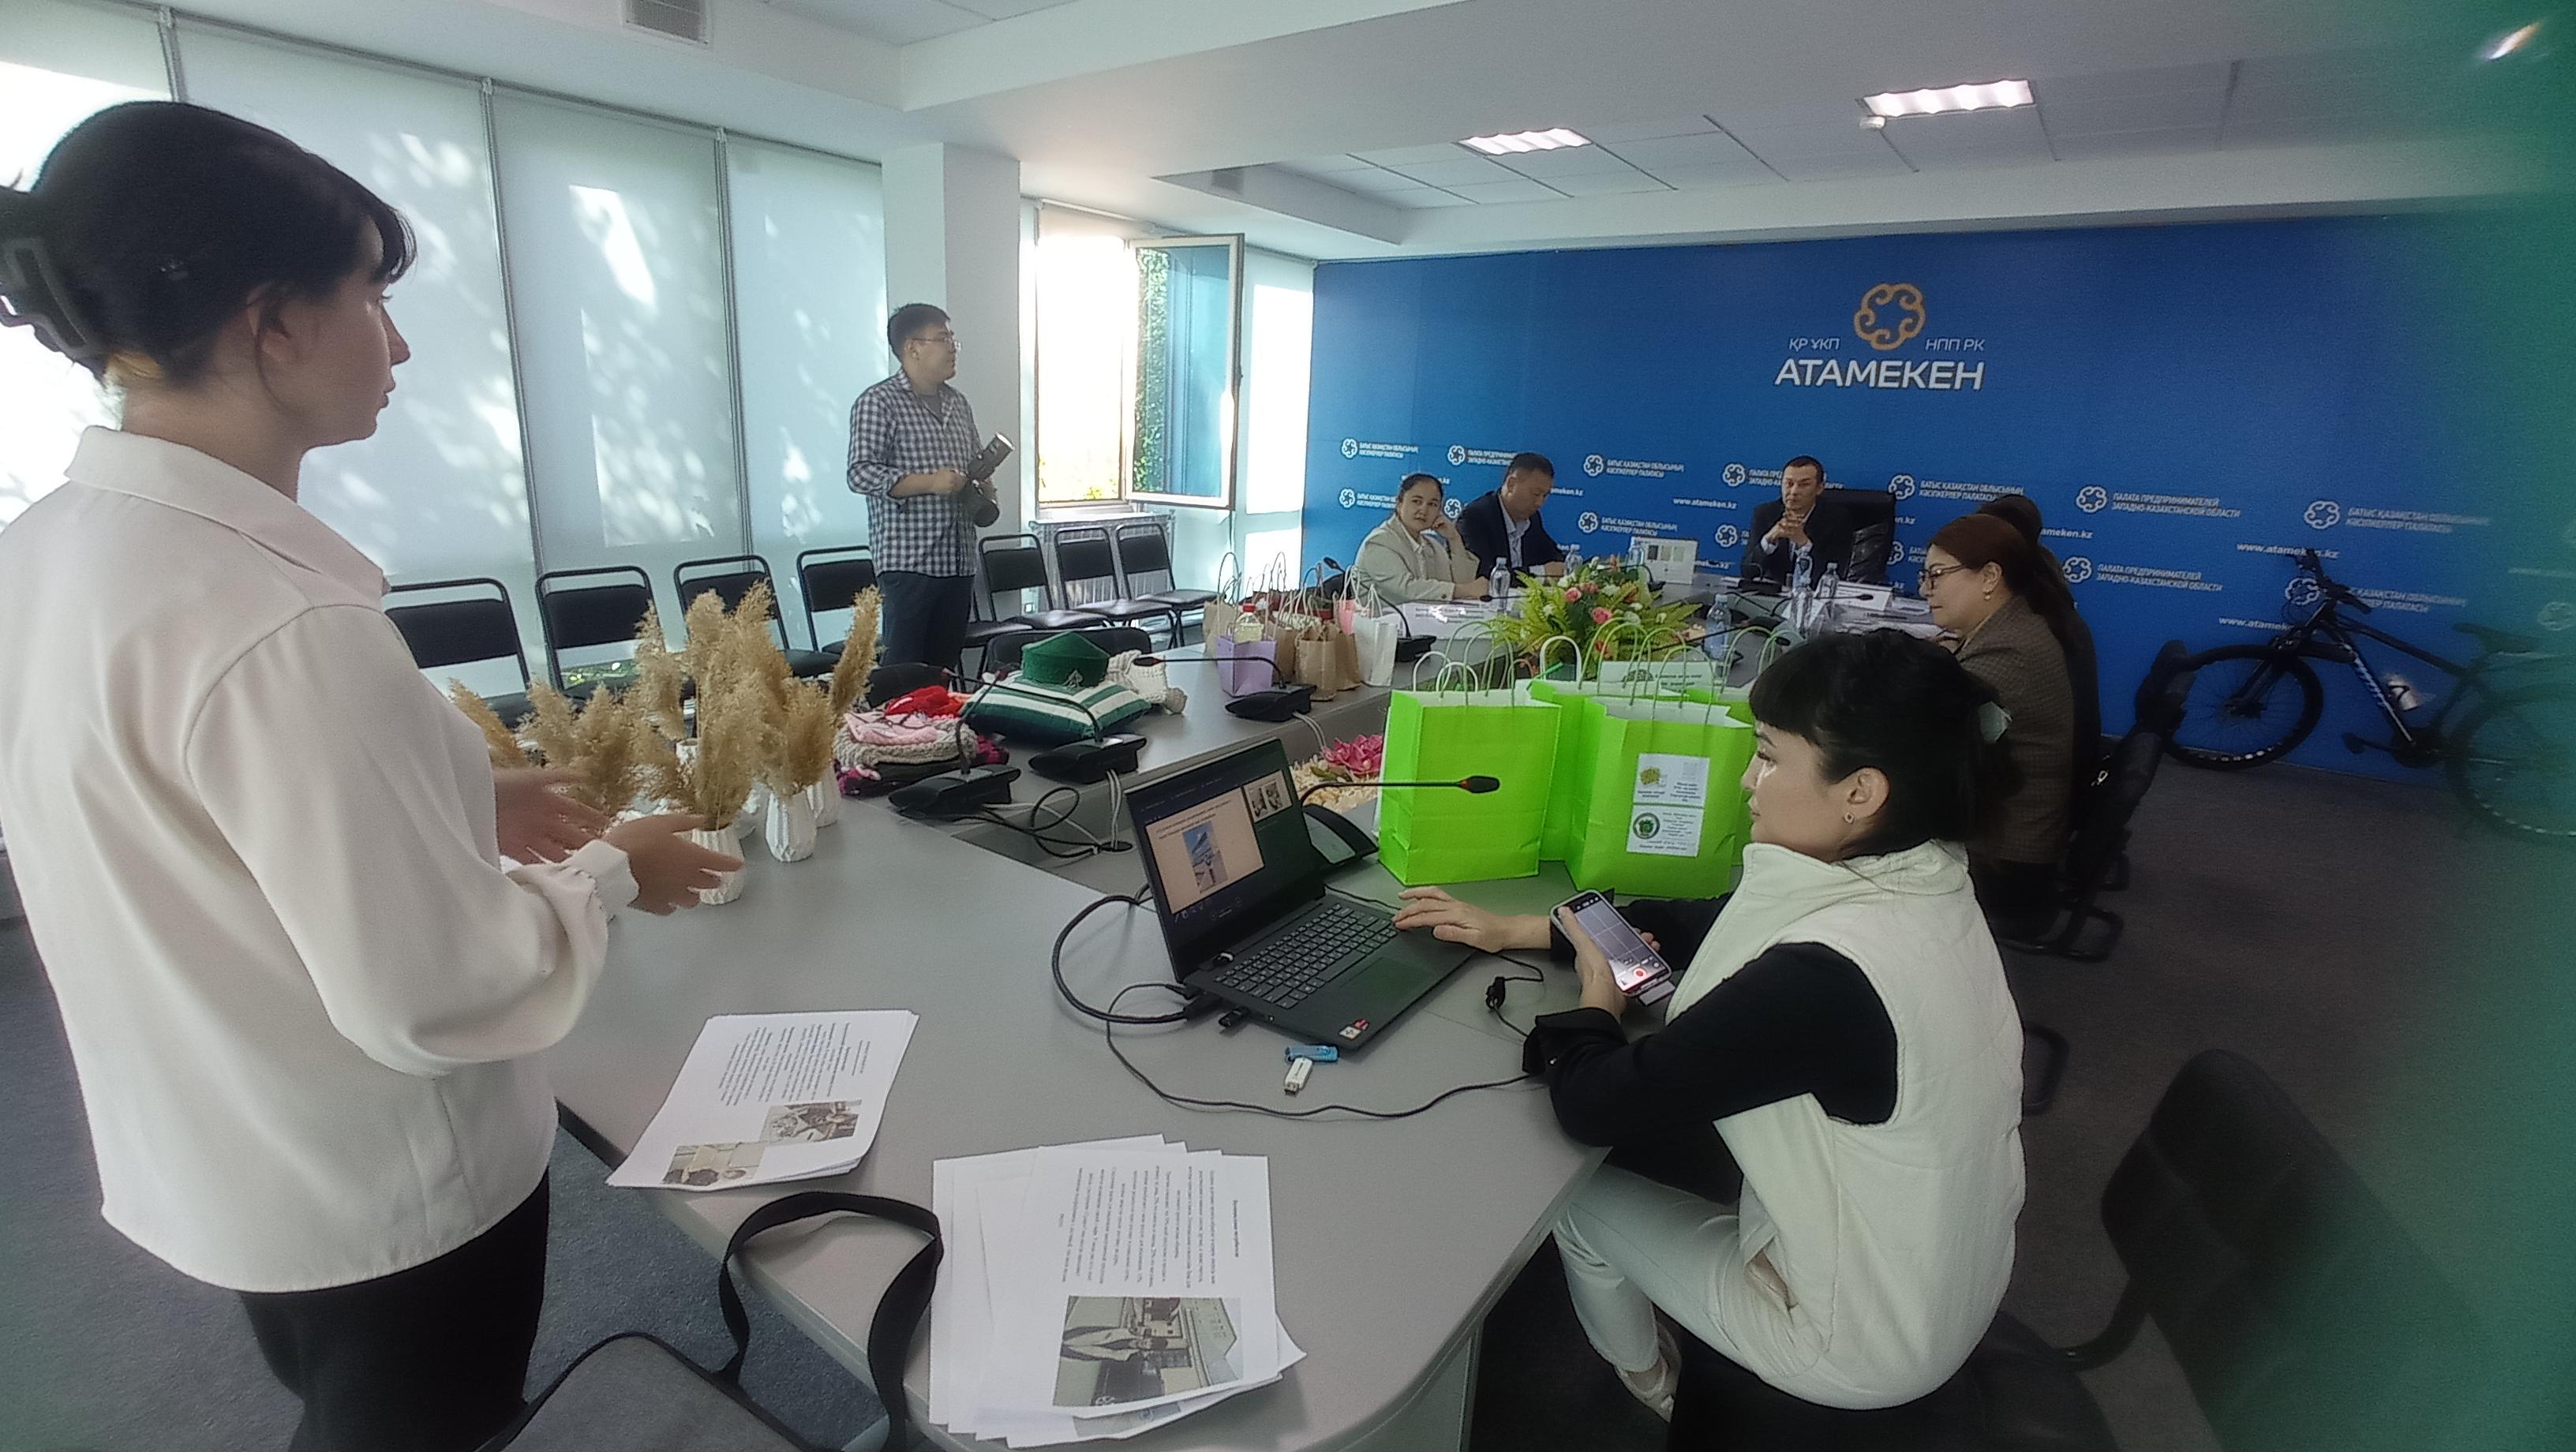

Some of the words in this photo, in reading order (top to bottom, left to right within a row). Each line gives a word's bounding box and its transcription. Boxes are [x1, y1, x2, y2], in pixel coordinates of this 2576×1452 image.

[1925, 338, 1961, 351] НПП
[1963, 339, 1985, 352] РК
[1774, 357, 1985, 390] АТАМЕКЕН
[2041, 527, 2093, 540] ameken.kz
[2237, 542, 2340, 559] www.atamekn.kz
[2218, 616, 2293, 631] www.atamek
